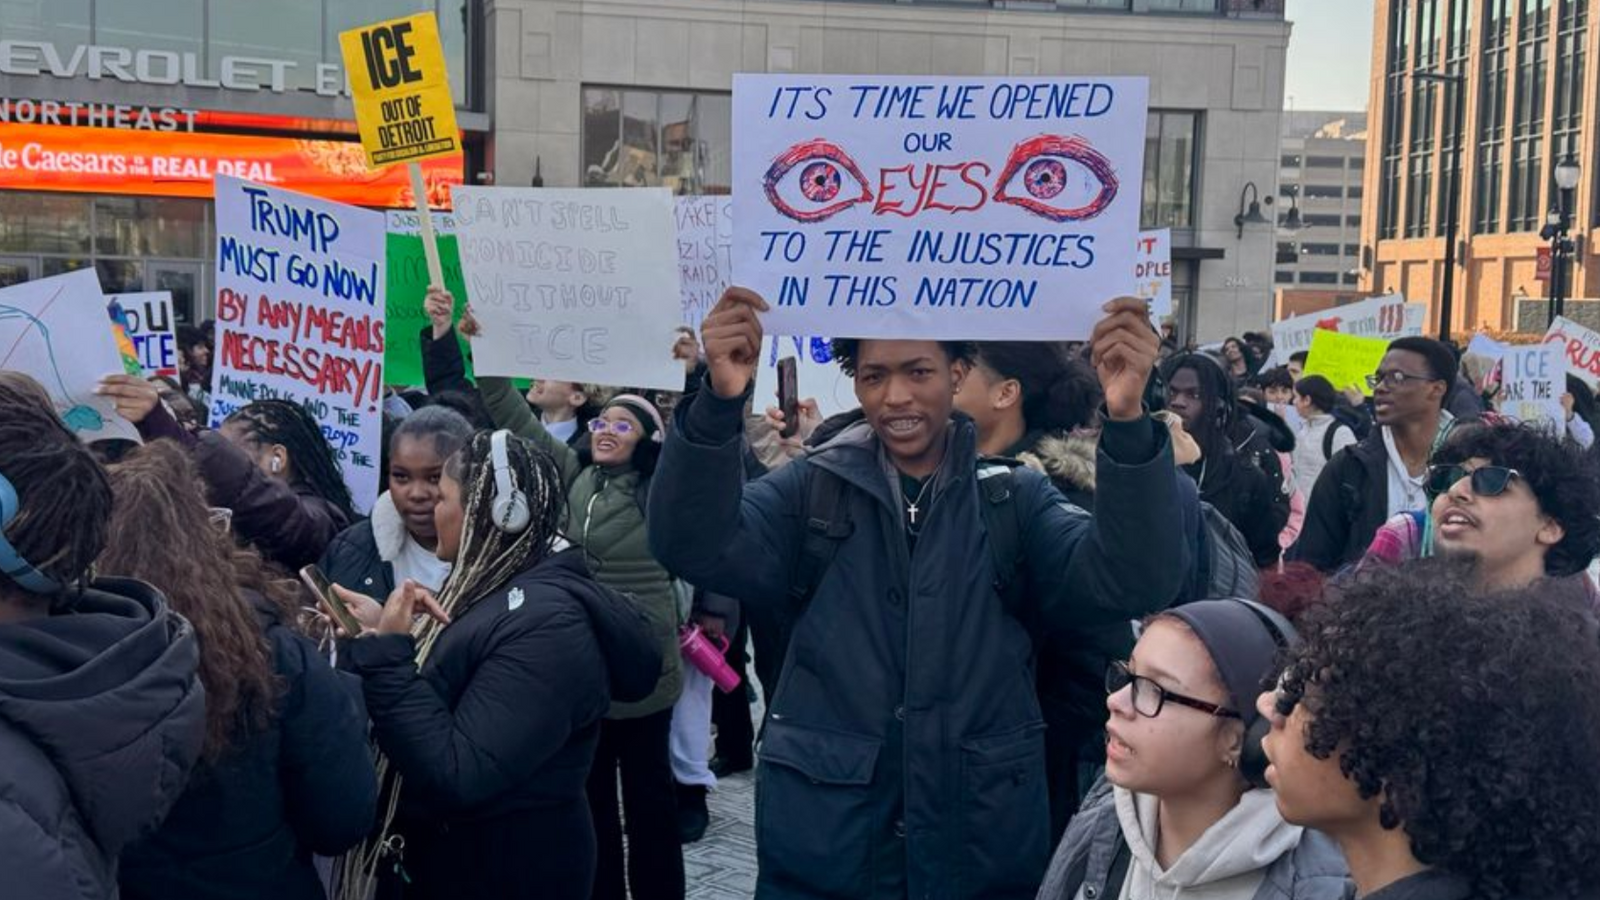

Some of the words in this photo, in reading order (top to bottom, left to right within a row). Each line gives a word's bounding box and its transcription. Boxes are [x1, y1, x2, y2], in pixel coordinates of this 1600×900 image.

[0, 41, 298, 92] EVROLET
[316, 62, 352, 97] E
[361, 22, 422, 90] ICE
[381, 98, 405, 122] OUT
[407, 95, 422, 118] OF
[768, 85, 832, 120] IT'S
[849, 85, 935, 119] TIME
[936, 85, 984, 119] WE
[990, 83, 1113, 120] OPENED
[378, 117, 436, 149] DETROIT
[904, 132, 953, 153] OUR
[22, 142, 127, 174] Caesars
[152, 157, 212, 179] REAL
[873, 161, 992, 217] EYES
[242, 187, 339, 253] TRUMP
[551, 201, 629, 233] SPELL
[462, 236, 618, 274] HOMICIDE
[760, 231, 806, 262] TO
[824, 229, 892, 263] THE
[906, 230, 1095, 268] INJUSTICES
[220, 236, 280, 283] MUST
[287, 254, 318, 288] GO
[323, 259, 377, 305] NOW
[472, 273, 632, 312] WITHOUT
[778, 277, 808, 306] IN
[824, 275, 897, 306] THIS
[914, 279, 1038, 307] NATION
[218, 288, 247, 327] BY
[258, 295, 302, 343] ANY
[305, 303, 384, 353] MEANS
[510, 323, 609, 365] ICE
[222, 329, 381, 412] NECESSARY!
[1515, 350, 1549, 378] ICE
[1505, 381, 1524, 401] ARE
[1531, 381, 1551, 399] THE
[332, 406, 361, 428] THE
[321, 425, 359, 450] FLOYD
[350, 450, 374, 468] THE
